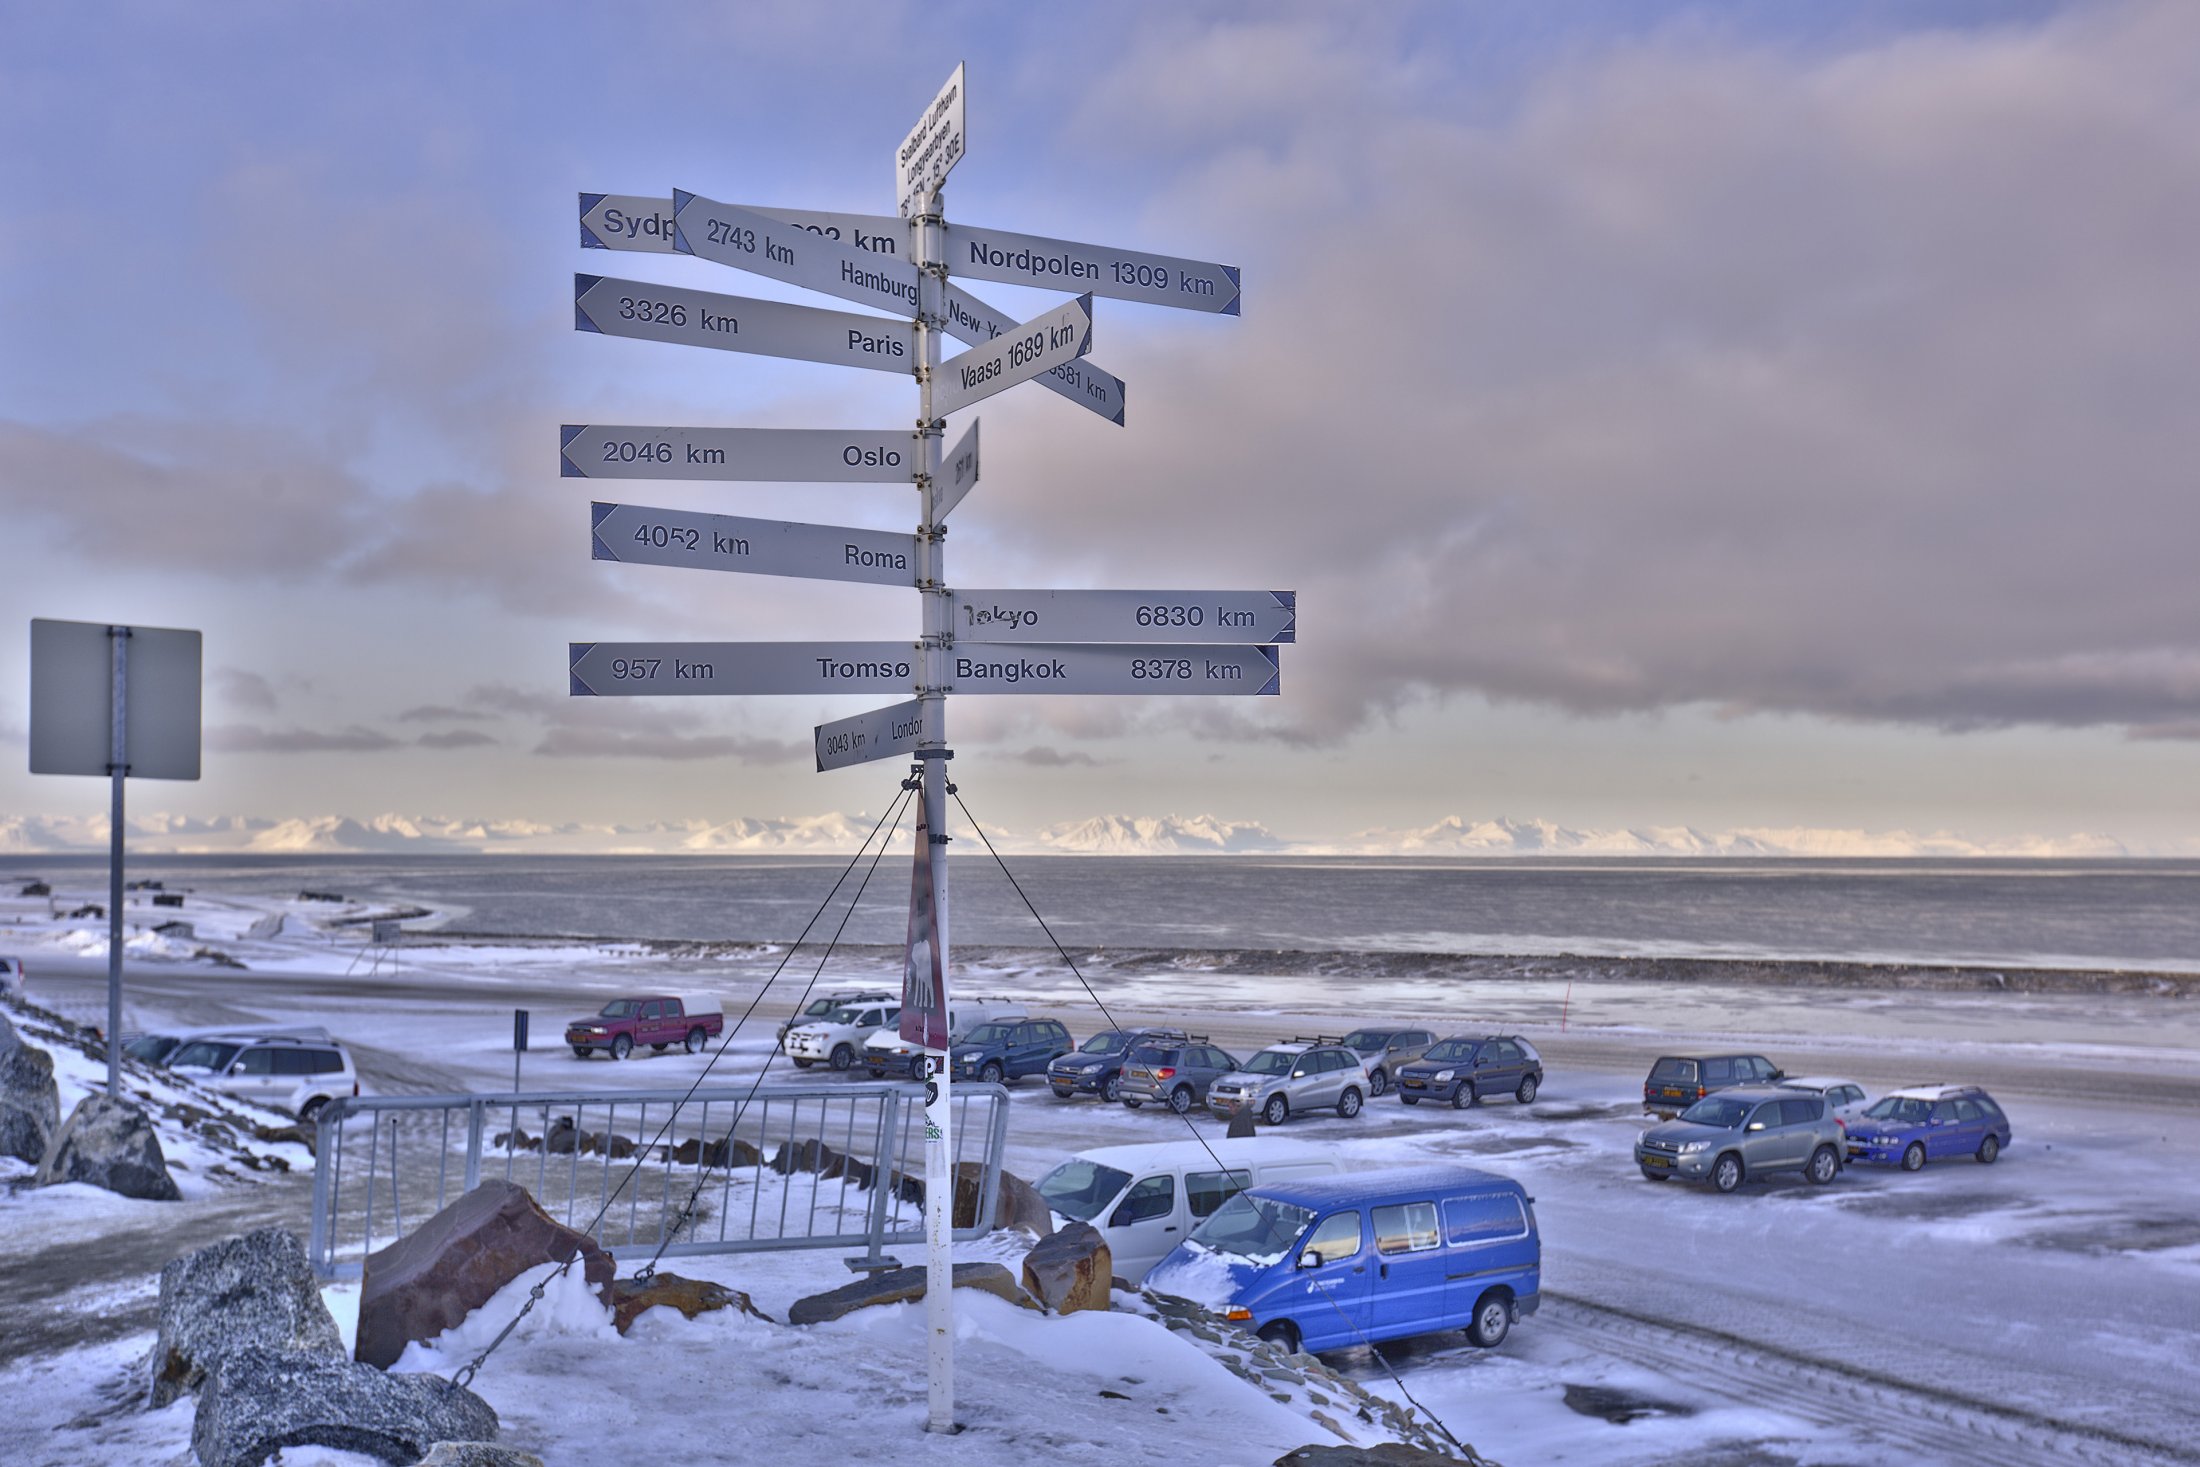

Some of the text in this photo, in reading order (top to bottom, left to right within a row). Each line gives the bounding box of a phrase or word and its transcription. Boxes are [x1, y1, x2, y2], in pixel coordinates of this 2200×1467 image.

[901, 84, 957, 169] Svalbard Lufthavn
[907, 120, 951, 186] Longyearbyen
[707, 218, 756, 254] 2743
[765, 236, 794, 266] km
[841, 259, 918, 307] Hamburg
[854, 229, 895, 254] km
[970, 241, 1214, 296] Nordpolen 1309 km
[619, 297, 904, 357] 3326 km Paris
[949, 298, 981, 333] New
[987, 320, 1003, 340] Y
[1087, 375, 1106, 403] km
[961, 323, 1074, 390] Vaasa 1689 km
[603, 441, 901, 467] 2046 km Oslo
[634, 524, 907, 570] 4052 km Roma
[963, 605, 1255, 630] Tokyo 6830 km
[612, 657, 910, 680] 957 km Tromsø
[956, 658, 1242, 683] Bangkok 8378 km
[827, 733, 849, 756] 3043
[851, 731, 866, 750] km
